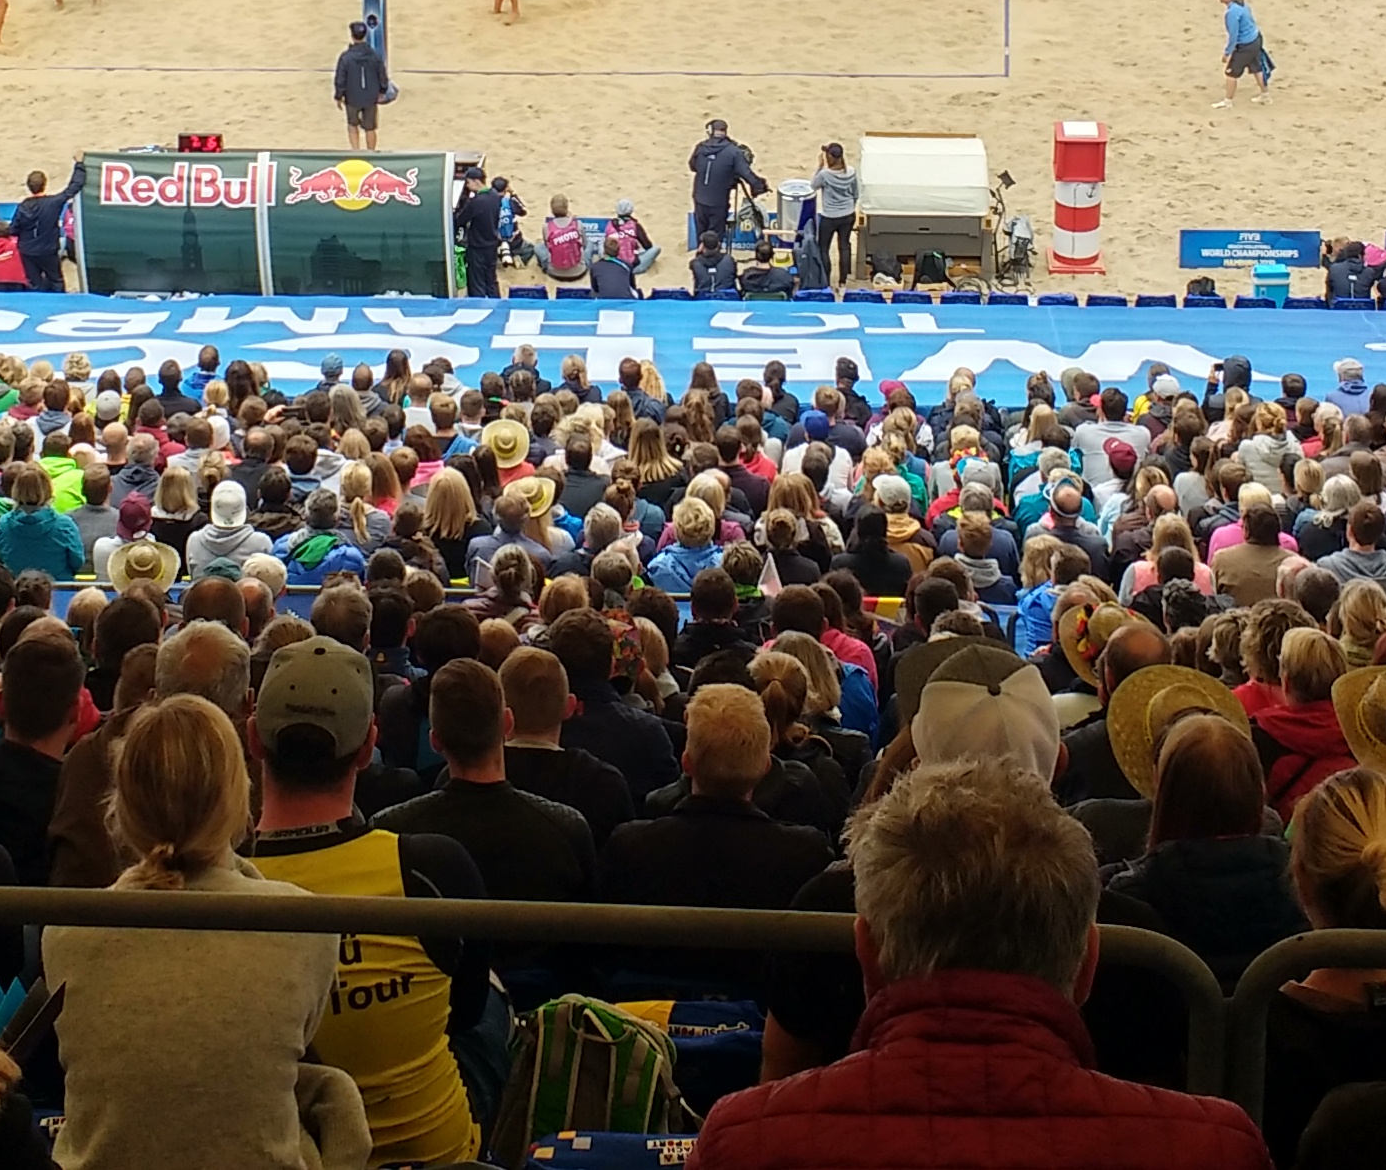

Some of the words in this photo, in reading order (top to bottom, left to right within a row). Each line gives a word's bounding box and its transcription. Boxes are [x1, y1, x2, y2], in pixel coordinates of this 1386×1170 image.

[101, 162, 189, 206] Red
[190, 161, 278, 206] Bull
[554, 231, 579, 245] PHOTO
[1201, 249, 1228, 258] WORLD
[1229, 249, 1299, 258] CHAMPIONSHIPS
